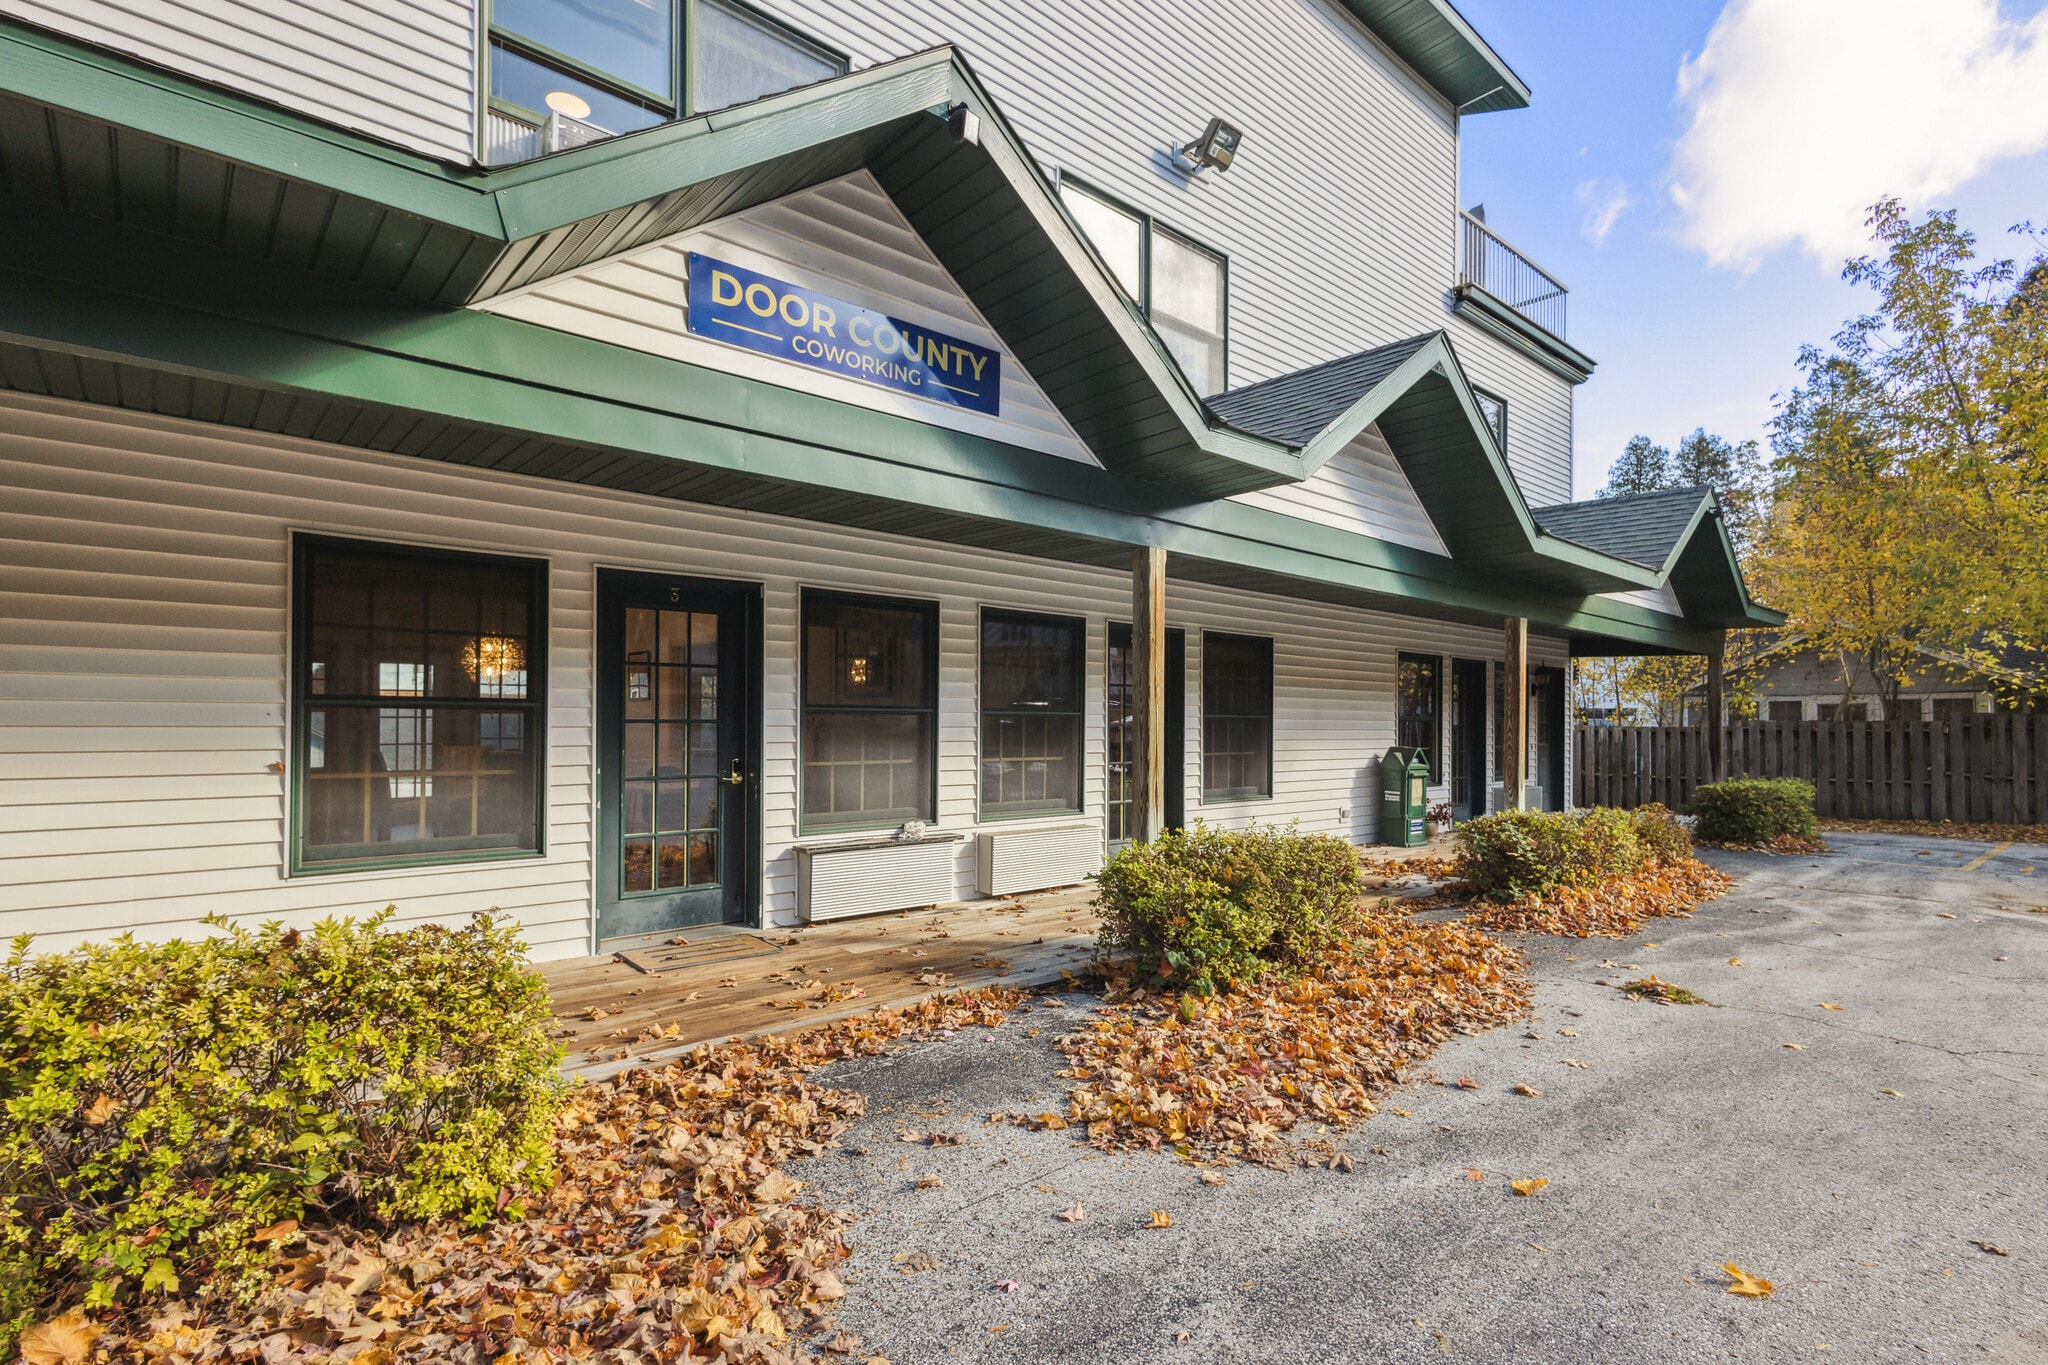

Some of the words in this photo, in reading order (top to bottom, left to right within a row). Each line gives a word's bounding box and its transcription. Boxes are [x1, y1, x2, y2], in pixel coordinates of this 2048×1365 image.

[711, 270, 836, 338] DOOR
[849, 316, 988, 381] COUNTY
[792, 335, 921, 386] COWORKING
[671, 587, 680, 602] 3
